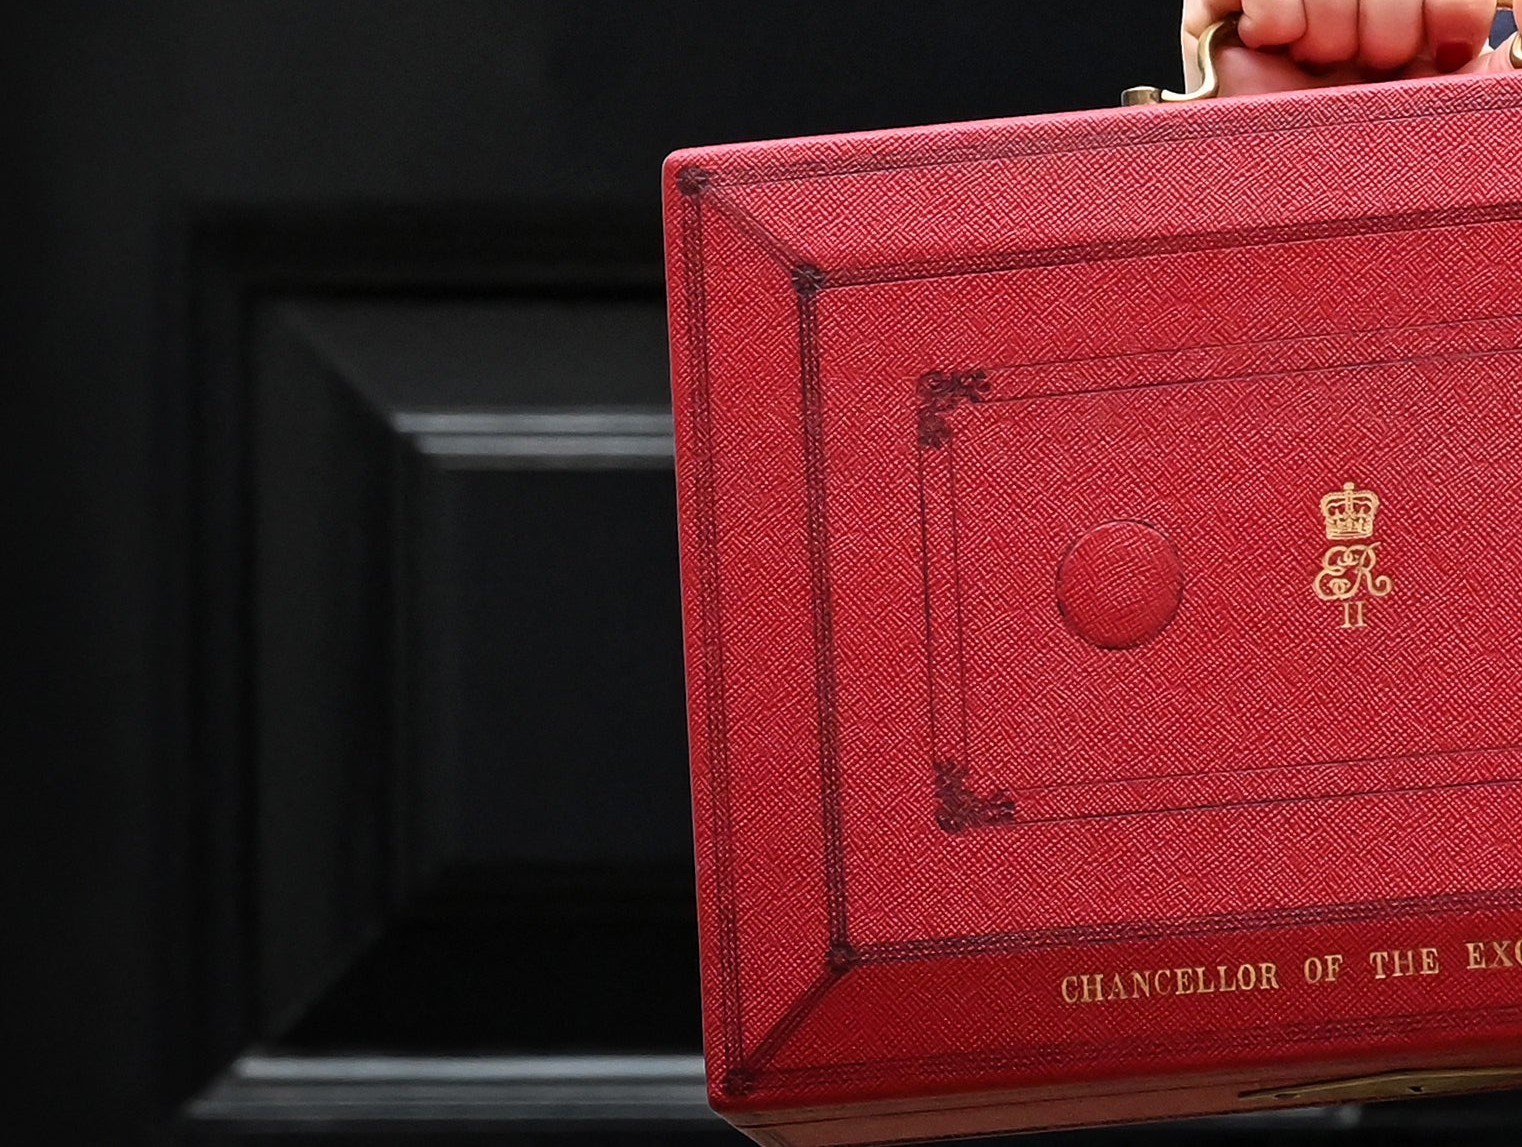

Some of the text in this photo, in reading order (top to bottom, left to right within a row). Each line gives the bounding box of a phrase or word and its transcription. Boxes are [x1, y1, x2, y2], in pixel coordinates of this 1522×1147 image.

[1340, 601, 1368, 629] II
[1061, 962, 1279, 1003] CHANCELLOR
[1303, 954, 1344, 984] OF
[1369, 947, 1440, 980] THE
